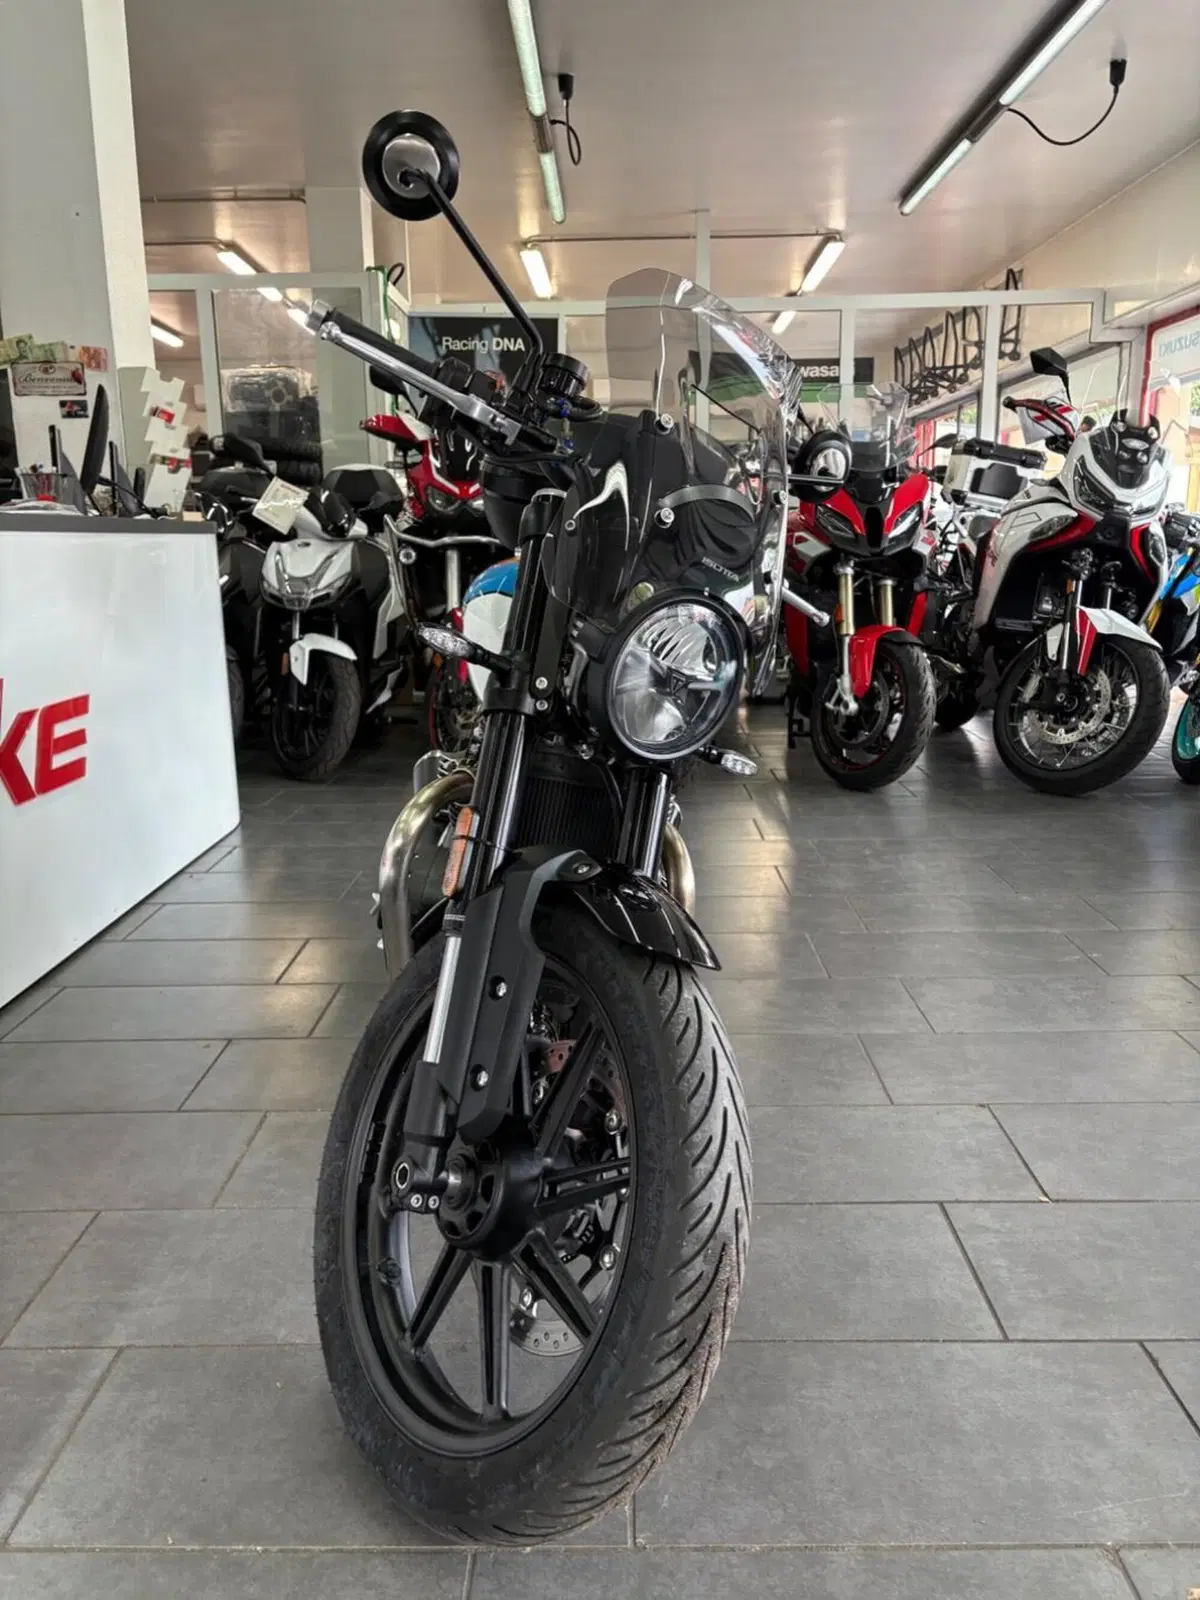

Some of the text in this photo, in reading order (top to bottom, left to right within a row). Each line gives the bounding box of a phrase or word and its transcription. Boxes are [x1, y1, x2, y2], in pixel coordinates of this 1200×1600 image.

[442, 336, 526, 354] Racing DNA
[799, 364, 840, 378] wasa
[0, 690, 90, 807] KE
